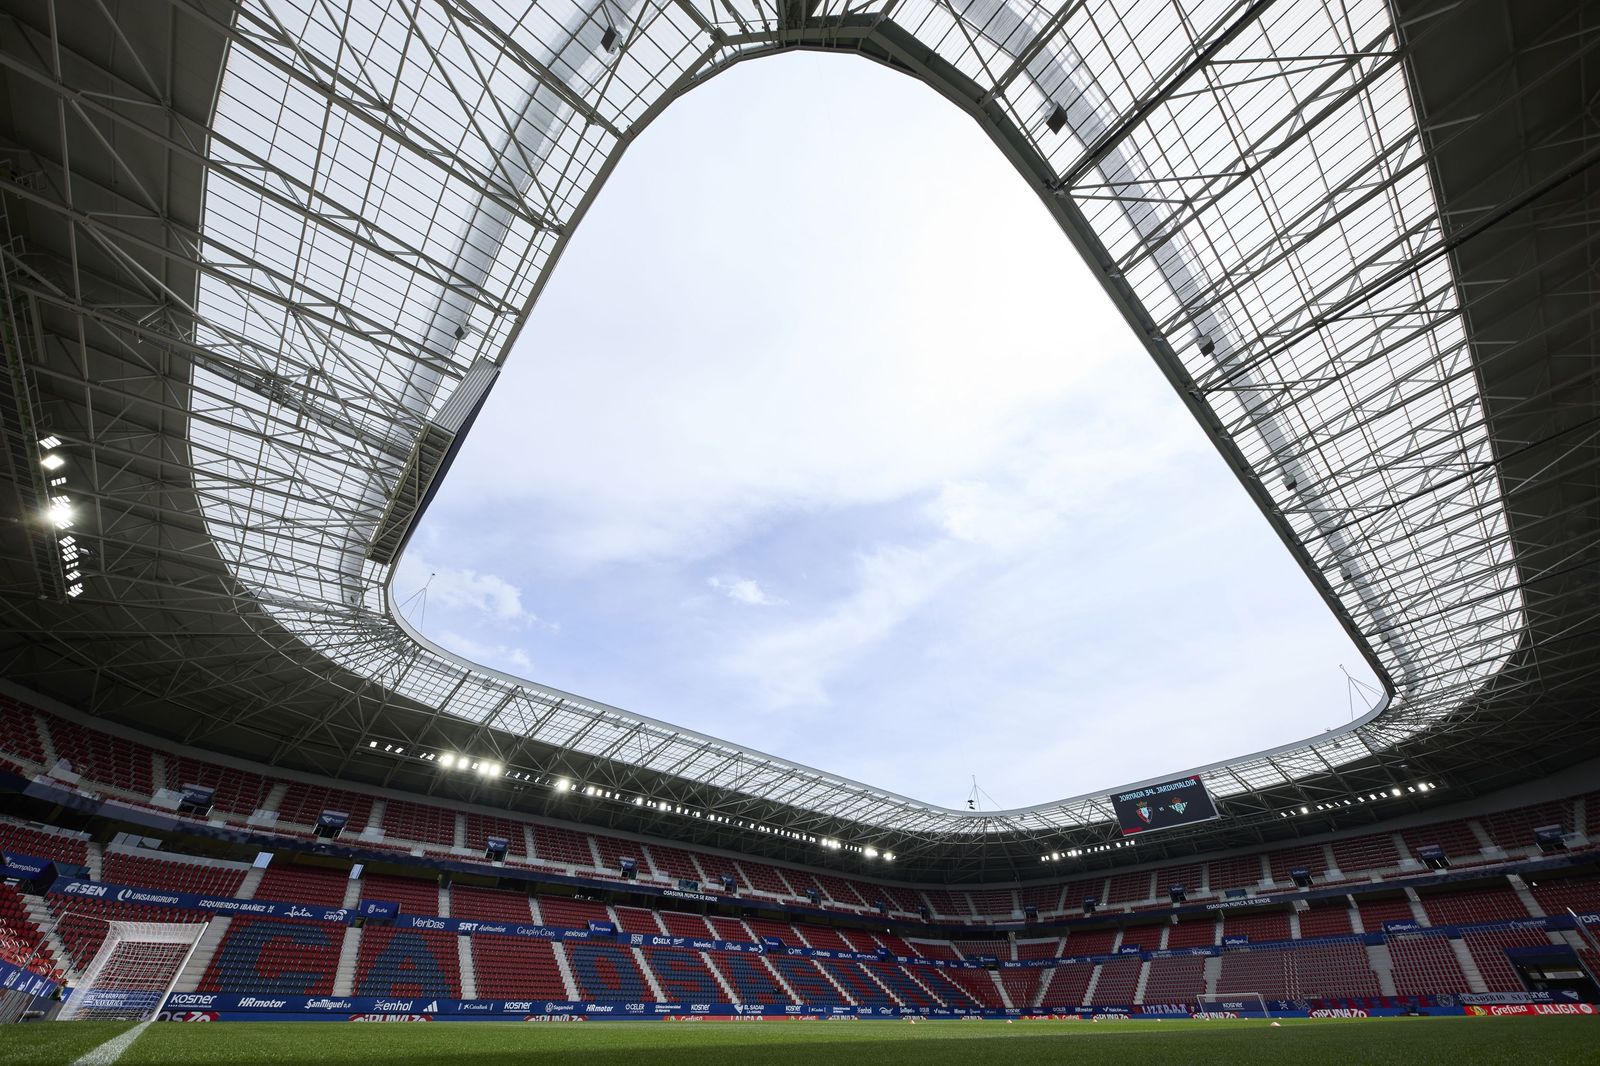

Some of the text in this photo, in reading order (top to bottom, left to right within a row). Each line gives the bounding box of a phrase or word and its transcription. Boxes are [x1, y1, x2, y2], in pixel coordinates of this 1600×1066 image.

[1119, 791, 1145, 803] JORNADA
[9, 862, 41, 873] Pamplona
[199, 900, 239, 910] IZQUIERDO
[1206, 902, 1229, 910] OSASUNA
[458, 922, 478, 931] SRT
[238, 997, 286, 1008] HRmotor
[382, 1000, 413, 1011] enhol
[586, 1004, 613, 1012] HRmotor
[1491, 1004, 1528, 1016] Grefusa
[1534, 1003, 1580, 1014] LALIGA
